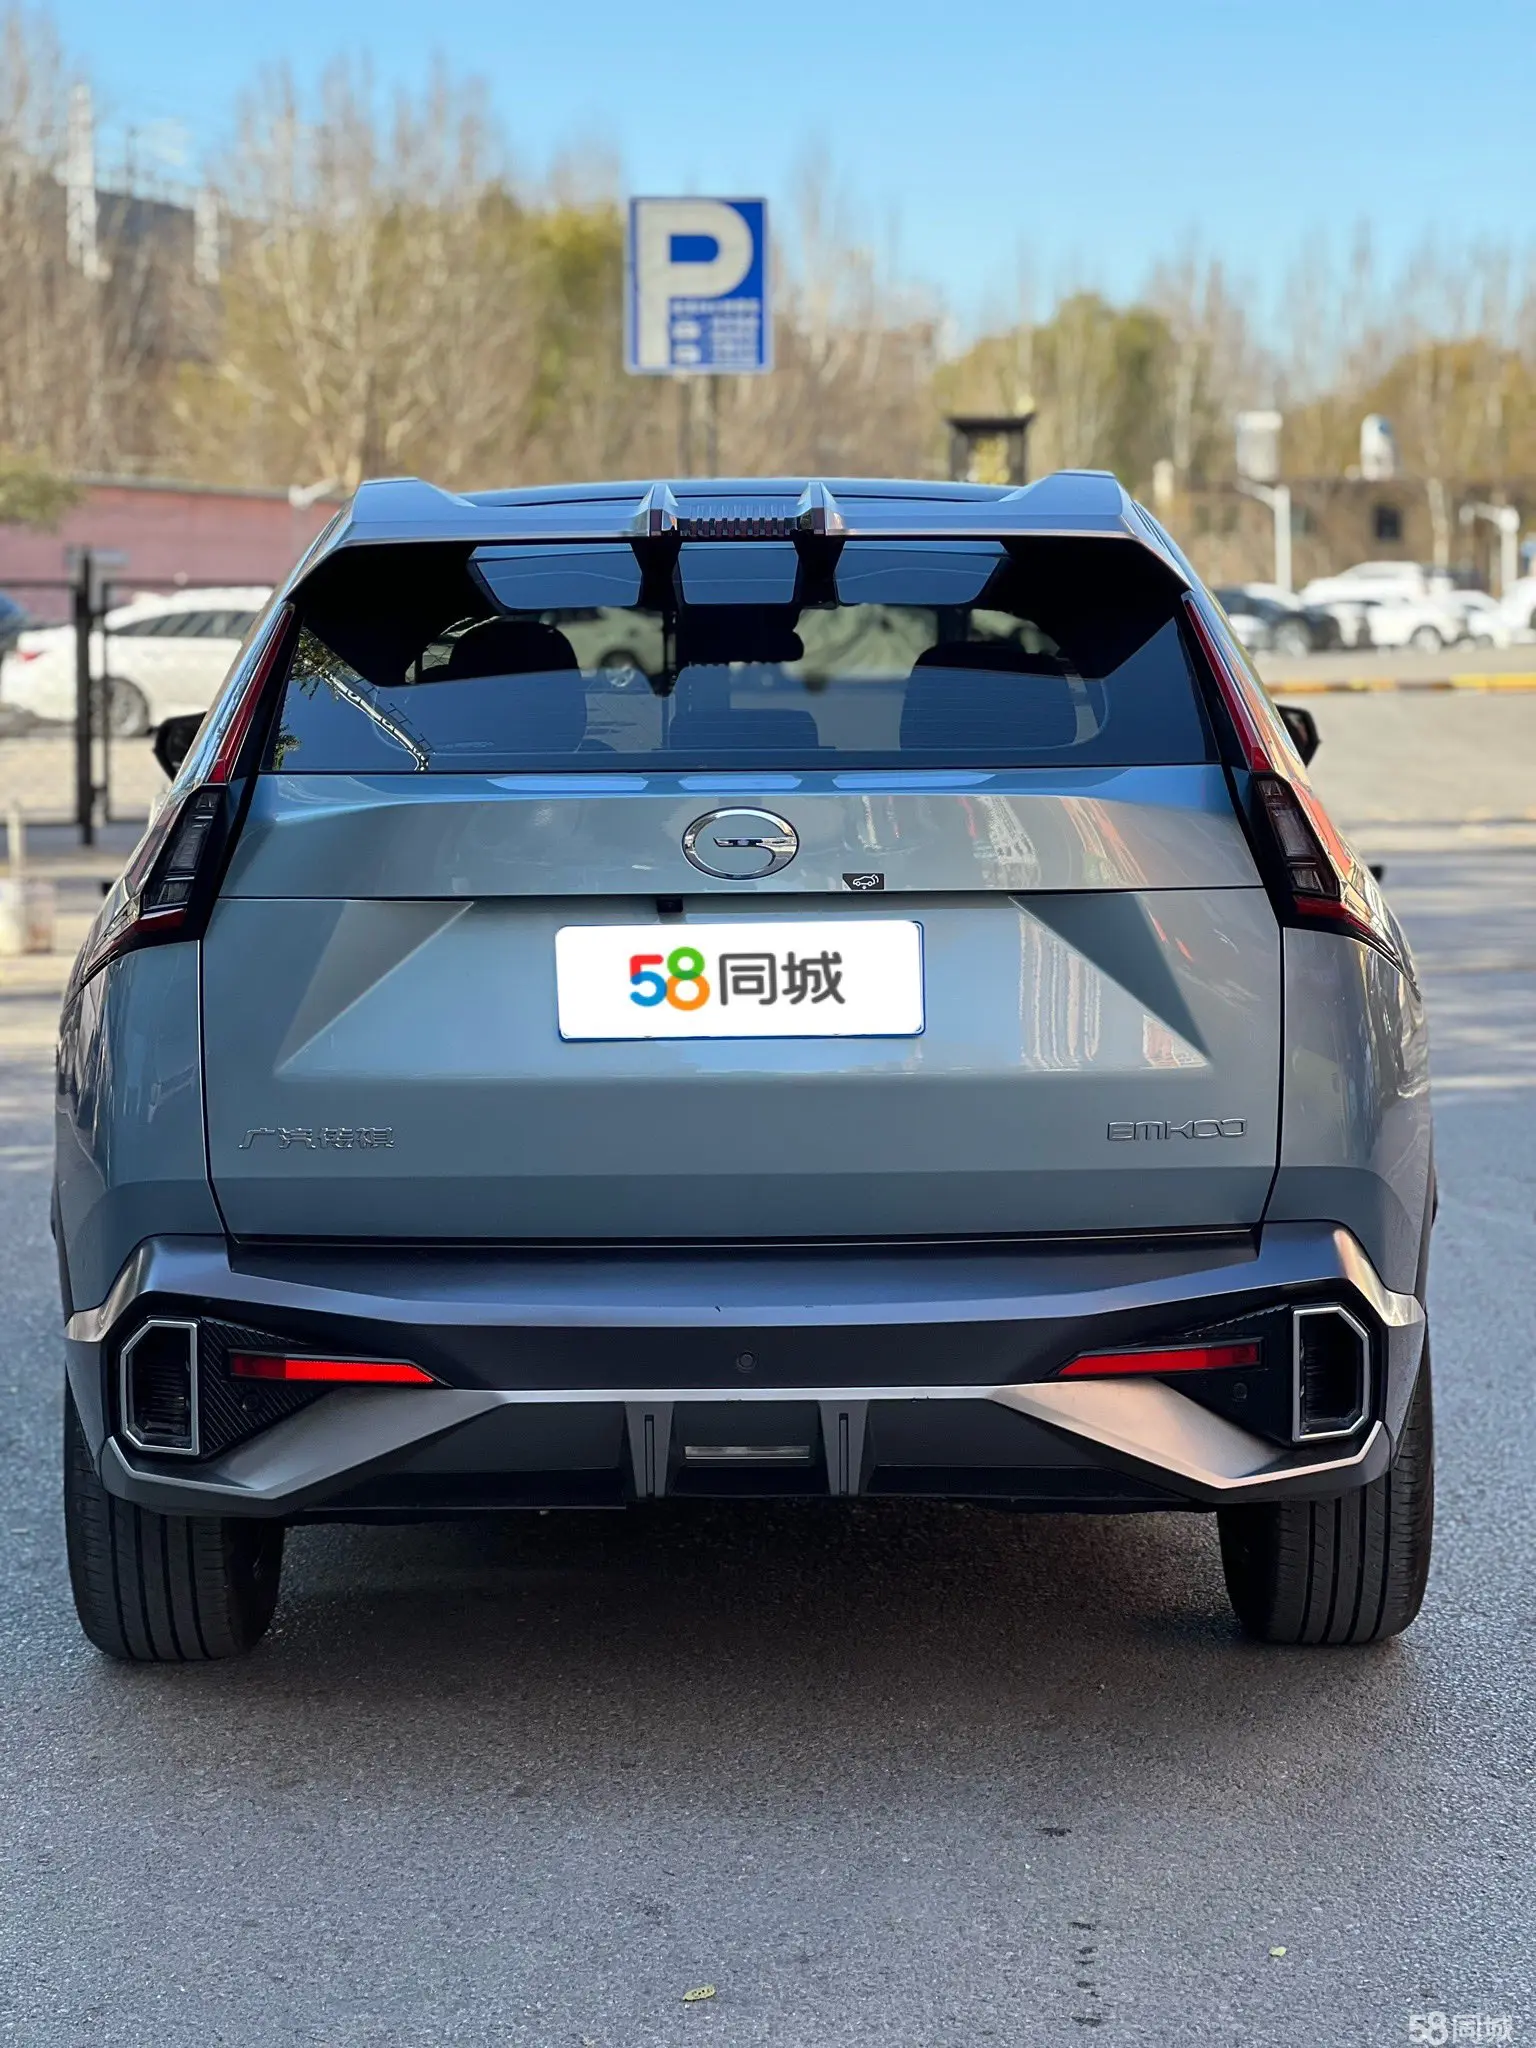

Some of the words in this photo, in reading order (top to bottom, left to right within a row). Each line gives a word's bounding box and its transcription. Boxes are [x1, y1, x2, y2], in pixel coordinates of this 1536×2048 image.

[636, 201, 754, 368] P
[238, 1126, 394, 1149] 广汽传祺
